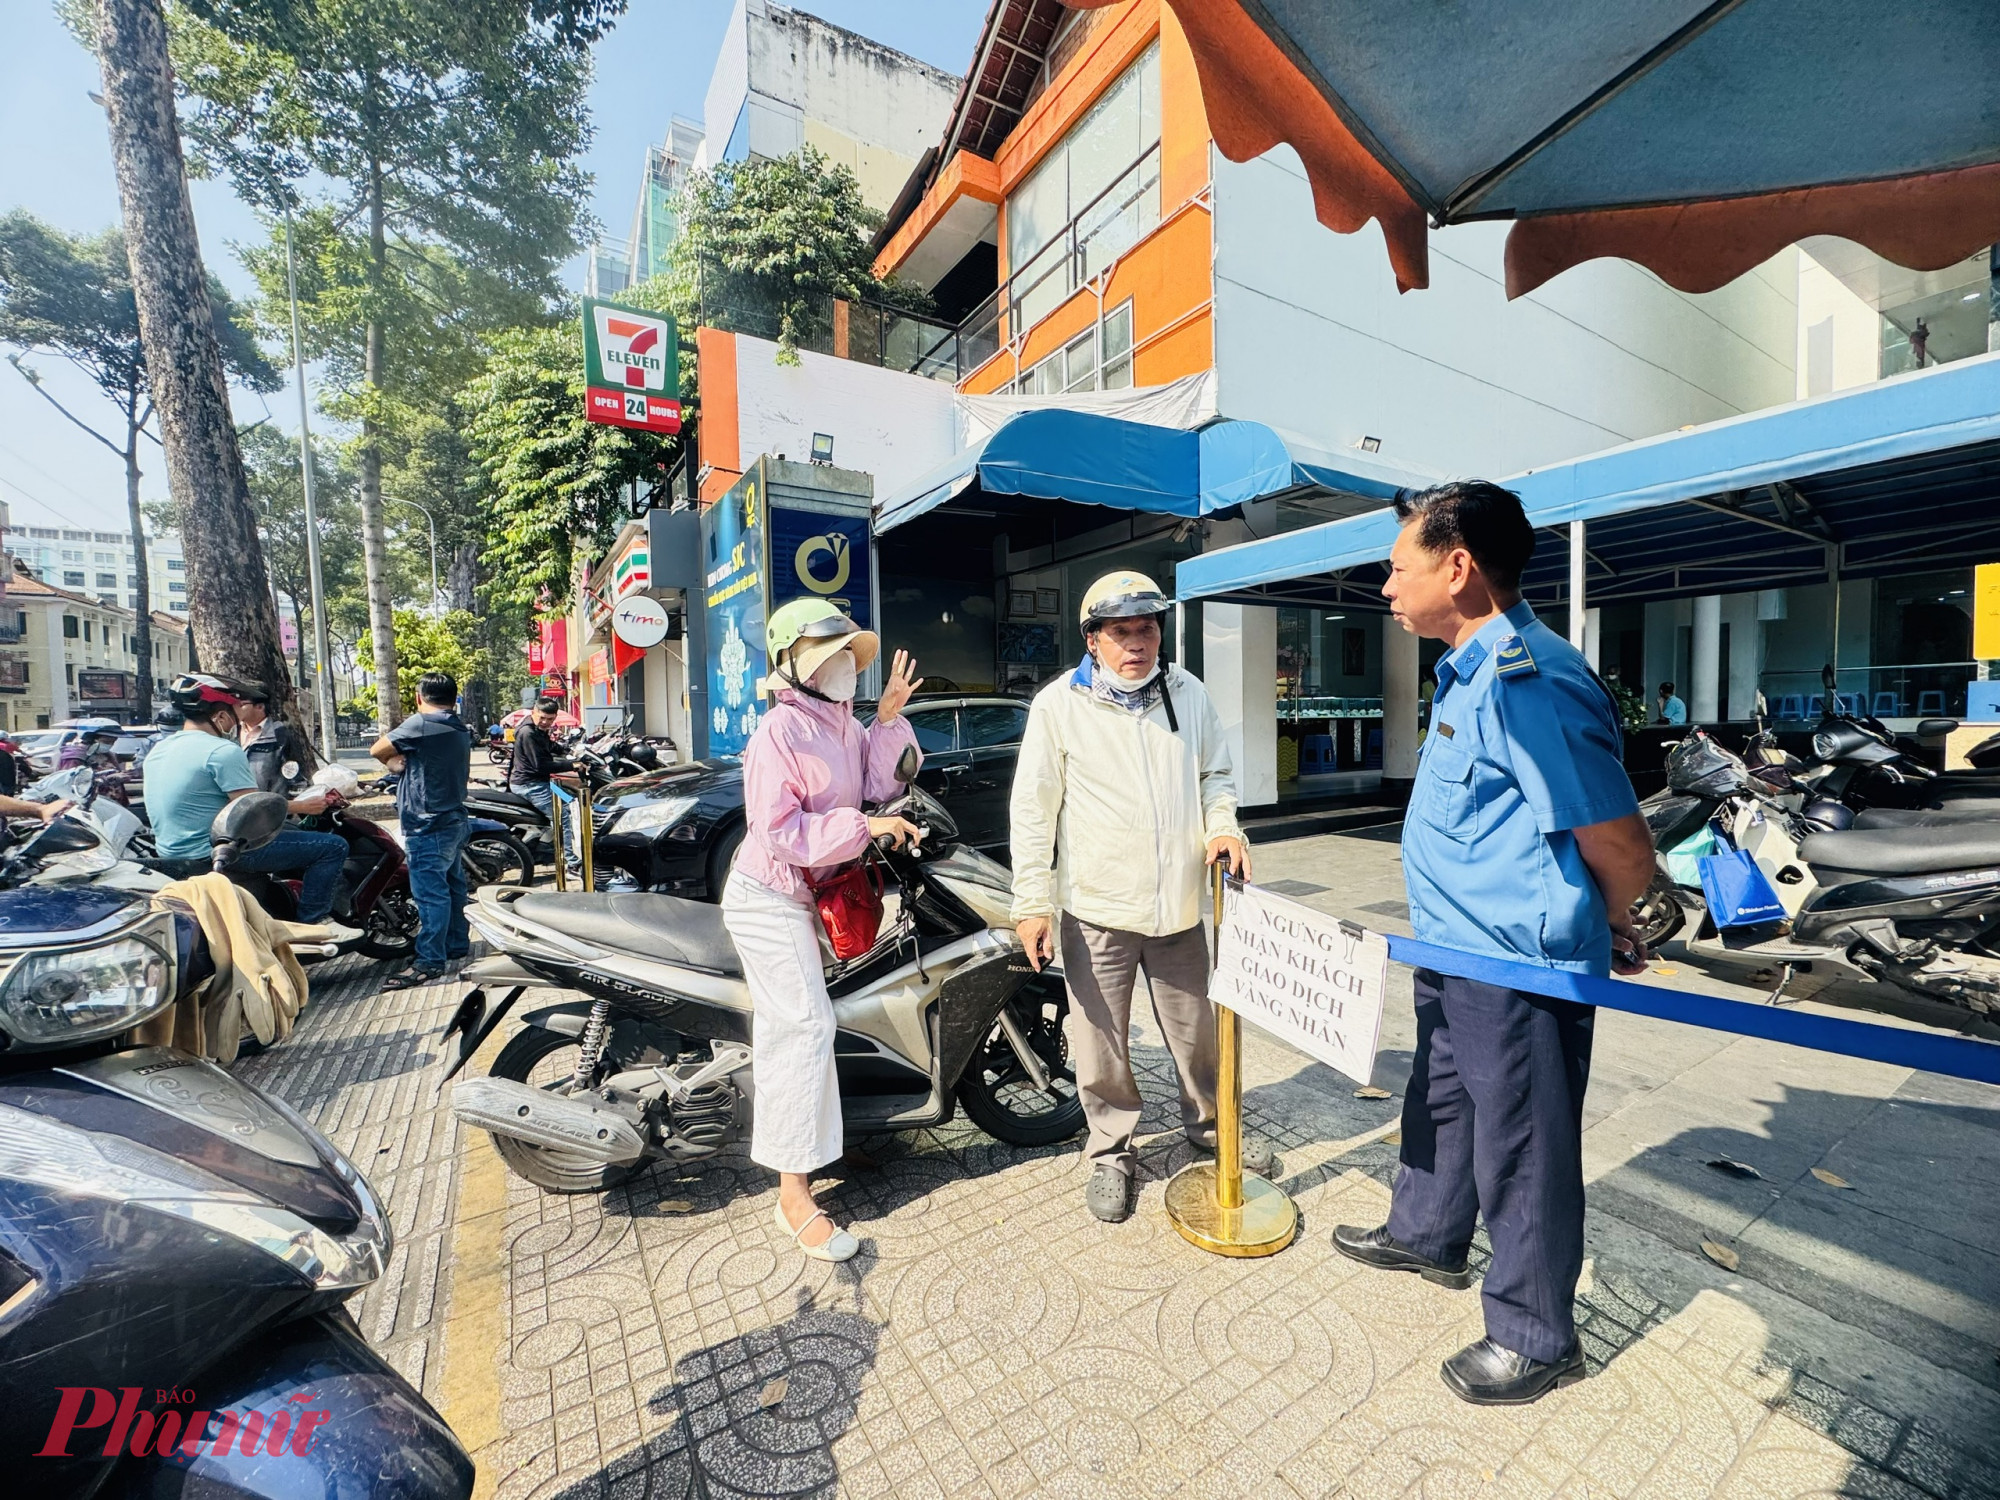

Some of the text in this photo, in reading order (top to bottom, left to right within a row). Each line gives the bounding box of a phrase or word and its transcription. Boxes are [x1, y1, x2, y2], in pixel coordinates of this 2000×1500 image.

[607, 317, 658, 388] 7
[594, 396, 678, 419] OPEN 24 HOURS
[619, 609, 664, 626] timo
[1007, 964, 1035, 973] HOND
[1287, 949, 1364, 997] KHÁCH
[1235, 977, 1283, 1017] VÀNG
[1241, 956, 1344, 1019] GIAO DỊCH
[134, 1060, 192, 1076] HOND
